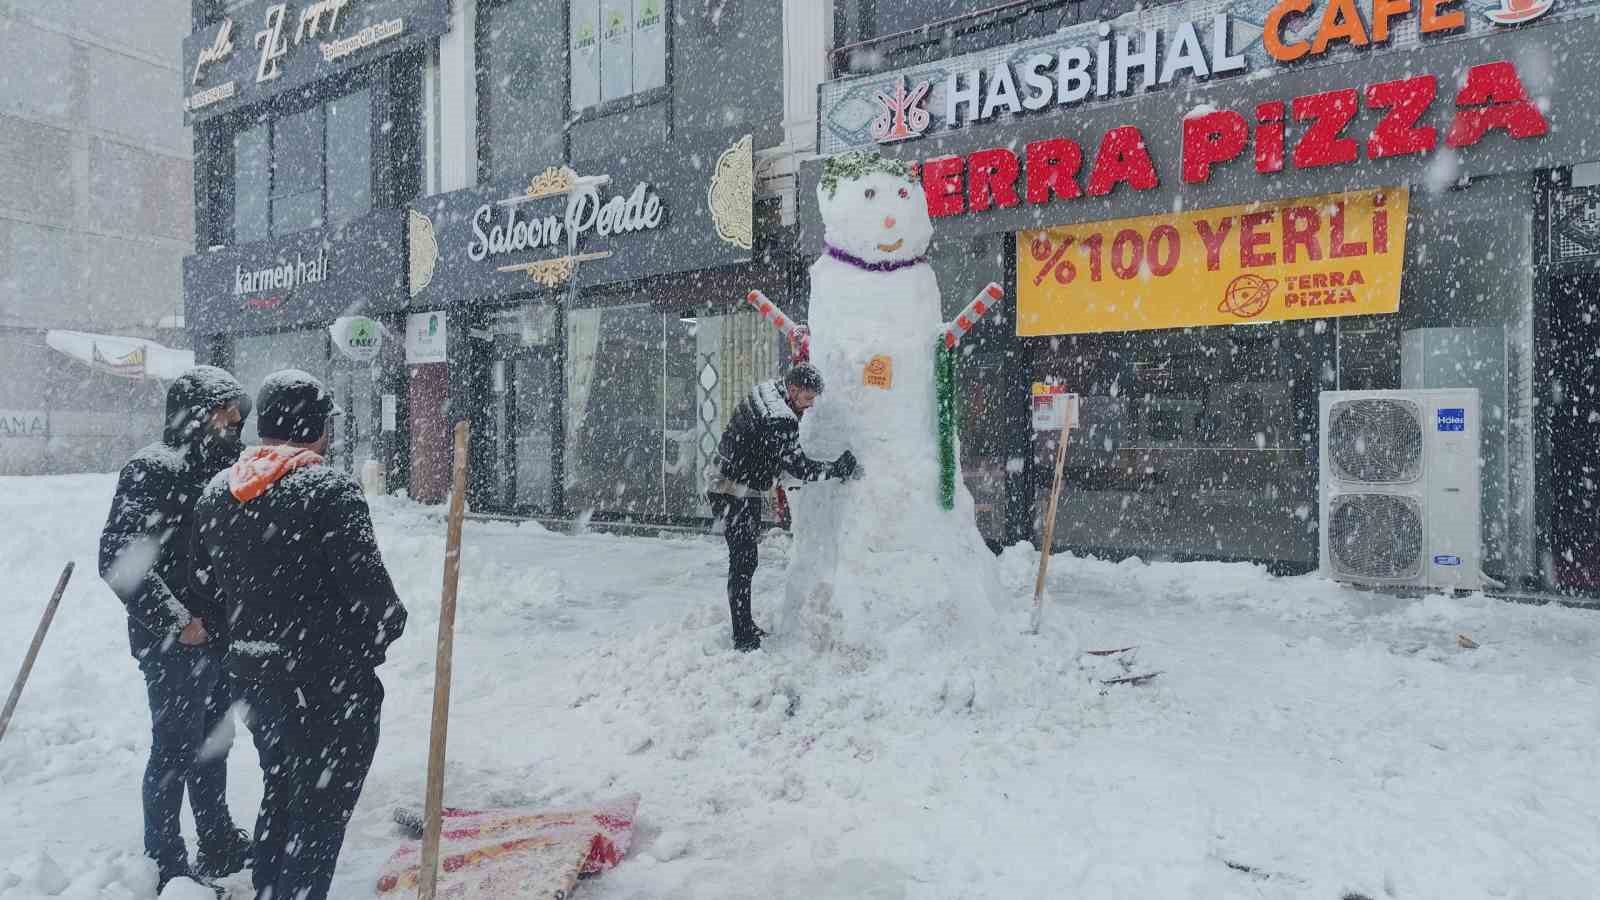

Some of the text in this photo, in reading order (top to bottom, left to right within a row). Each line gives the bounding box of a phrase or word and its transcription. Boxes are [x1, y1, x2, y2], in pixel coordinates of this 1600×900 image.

[1263, 0, 1465, 62] CAFE
[914, 125, 1159, 218] ERRA
[467, 183, 663, 261] Saloon Perde
[1031, 224, 1181, 287] %100
[1286, 270, 1366, 291] TERRA
